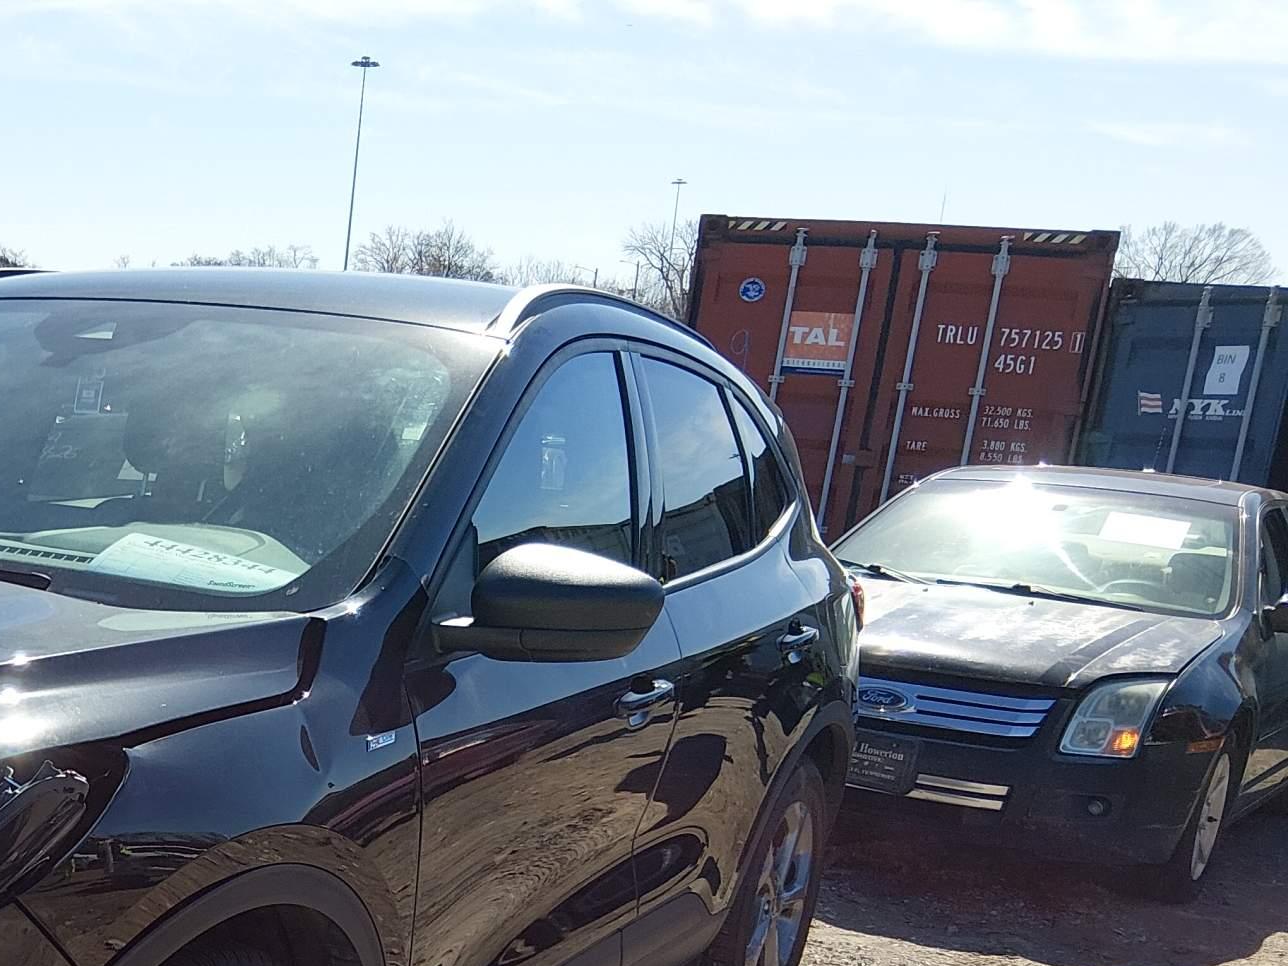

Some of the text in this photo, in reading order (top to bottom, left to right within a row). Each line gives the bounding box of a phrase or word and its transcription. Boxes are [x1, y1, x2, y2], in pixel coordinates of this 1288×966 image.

[790, 326, 845, 347] TAL
[937, 325, 978, 345] TRLU
[1000, 328, 1062, 350] 757125
[994, 354, 1035, 375] 45G1
[1216, 354, 1237, 365] BIN
[1225, 408, 1245, 417] LIN
[906, 440, 928, 451] TARE
[143, 540, 277, 574] 44428344
[862, 690, 894, 704] Ford
